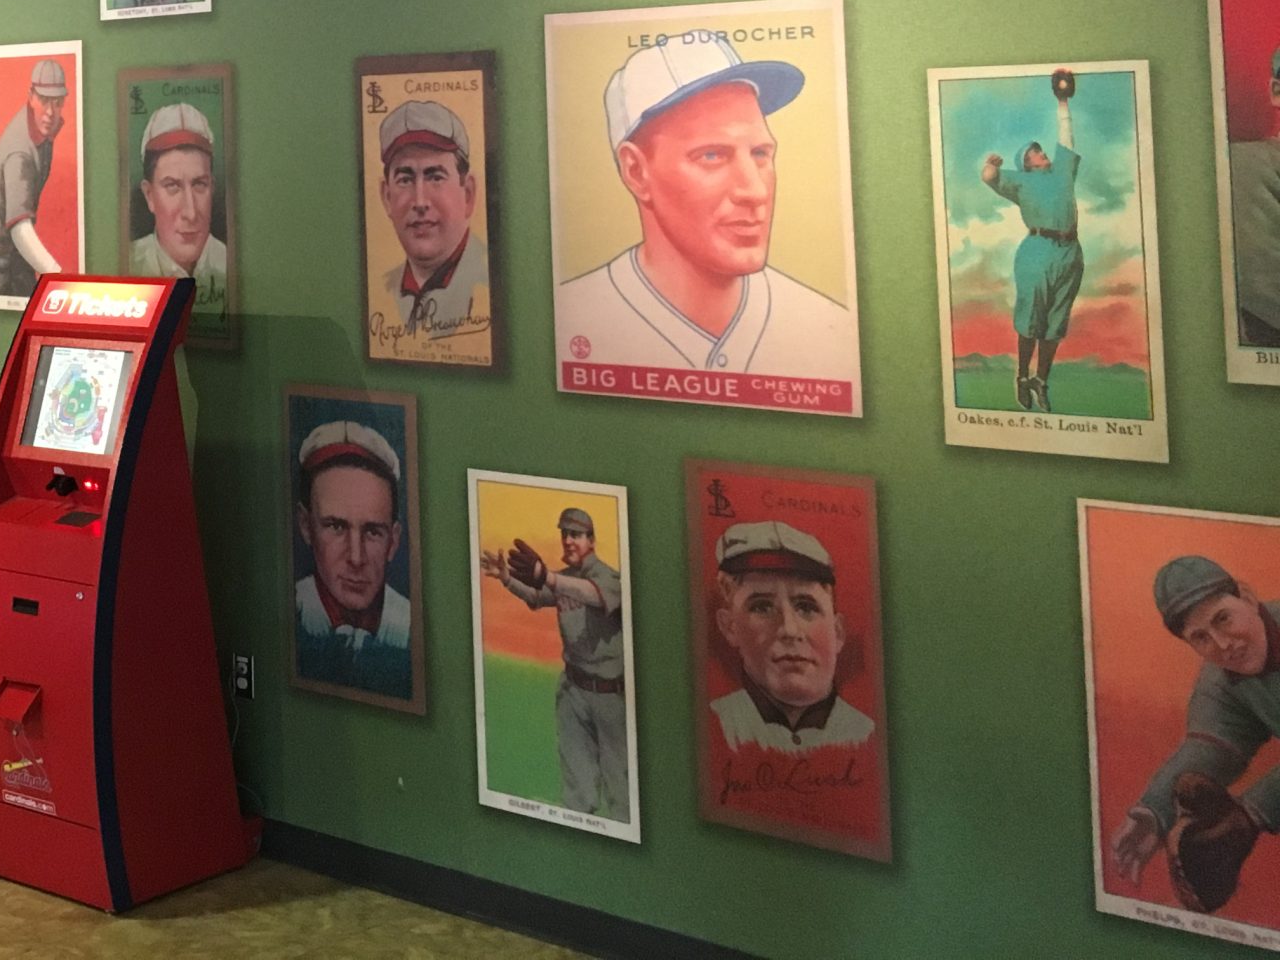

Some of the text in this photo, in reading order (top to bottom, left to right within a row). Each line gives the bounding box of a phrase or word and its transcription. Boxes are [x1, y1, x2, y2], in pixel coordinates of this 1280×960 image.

[627, 26, 816, 48] LEO DUROCHER
[162, 82, 220, 97] CARDINALS
[404, 79, 479, 94] CARDINALS
[67, 293, 149, 319] Tickets
[572, 367, 842, 398] BIG LEAGUE CHEWING
[773, 391, 821, 406] GUM
[957, 412, 1004, 428] Oakes,
[1034, 417, 1054, 430] St.
[1058, 419, 1098, 433] Louis
[1106, 422, 1144, 436] Nat'l
[761, 491, 862, 518] CARDINALS
